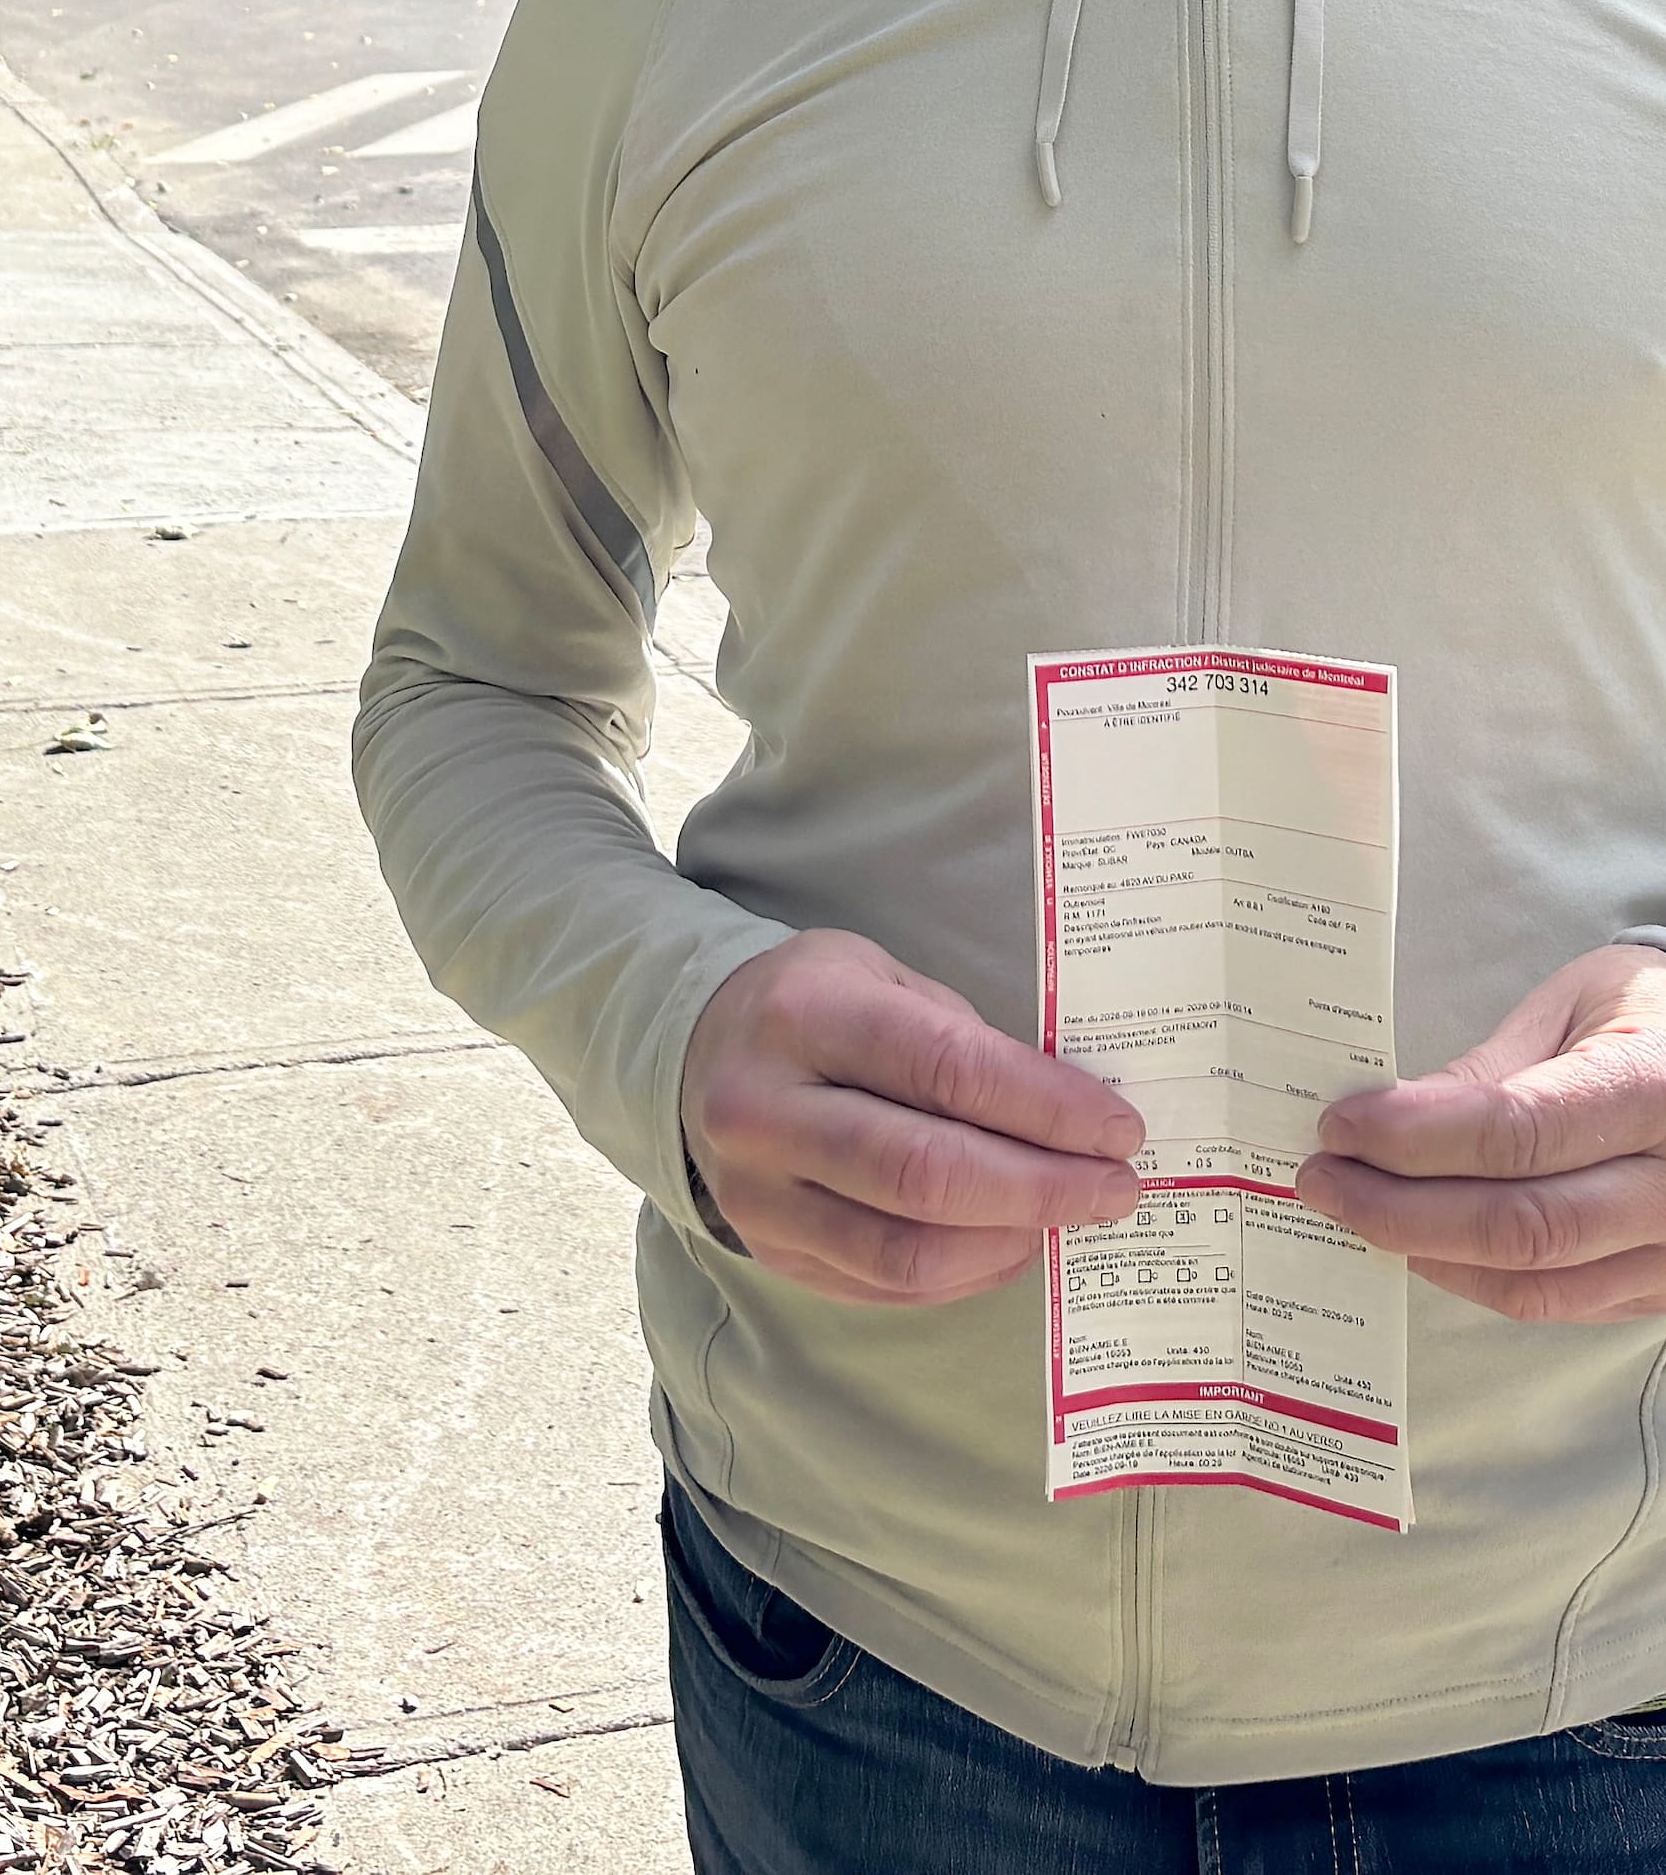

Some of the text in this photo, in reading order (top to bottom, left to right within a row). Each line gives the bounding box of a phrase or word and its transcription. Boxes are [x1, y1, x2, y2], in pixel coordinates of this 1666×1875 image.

[1059, 664, 1114, 678] CONSTAT
[1118, 657, 1202, 673] D'INFRACTION
[1211, 654, 1250, 670] District
[1302, 668, 1315, 678] de
[1166, 674, 1268, 696] 342 703 314
[1199, 1386, 1265, 1405] IMPORTANT
[1071, 1413, 1122, 1432] VEUILLEZ
[1125, 1411, 1151, 1421] LIRE
[1154, 1410, 1170, 1420] LA
[1172, 1409, 1202, 1419] MISE
[1205, 1409, 1222, 1419] EN
[1225, 1409, 1261, 1426] GARDE
[1289, 1427, 1305, 1439] AU
[1306, 1432, 1343, 1451] VERSO
